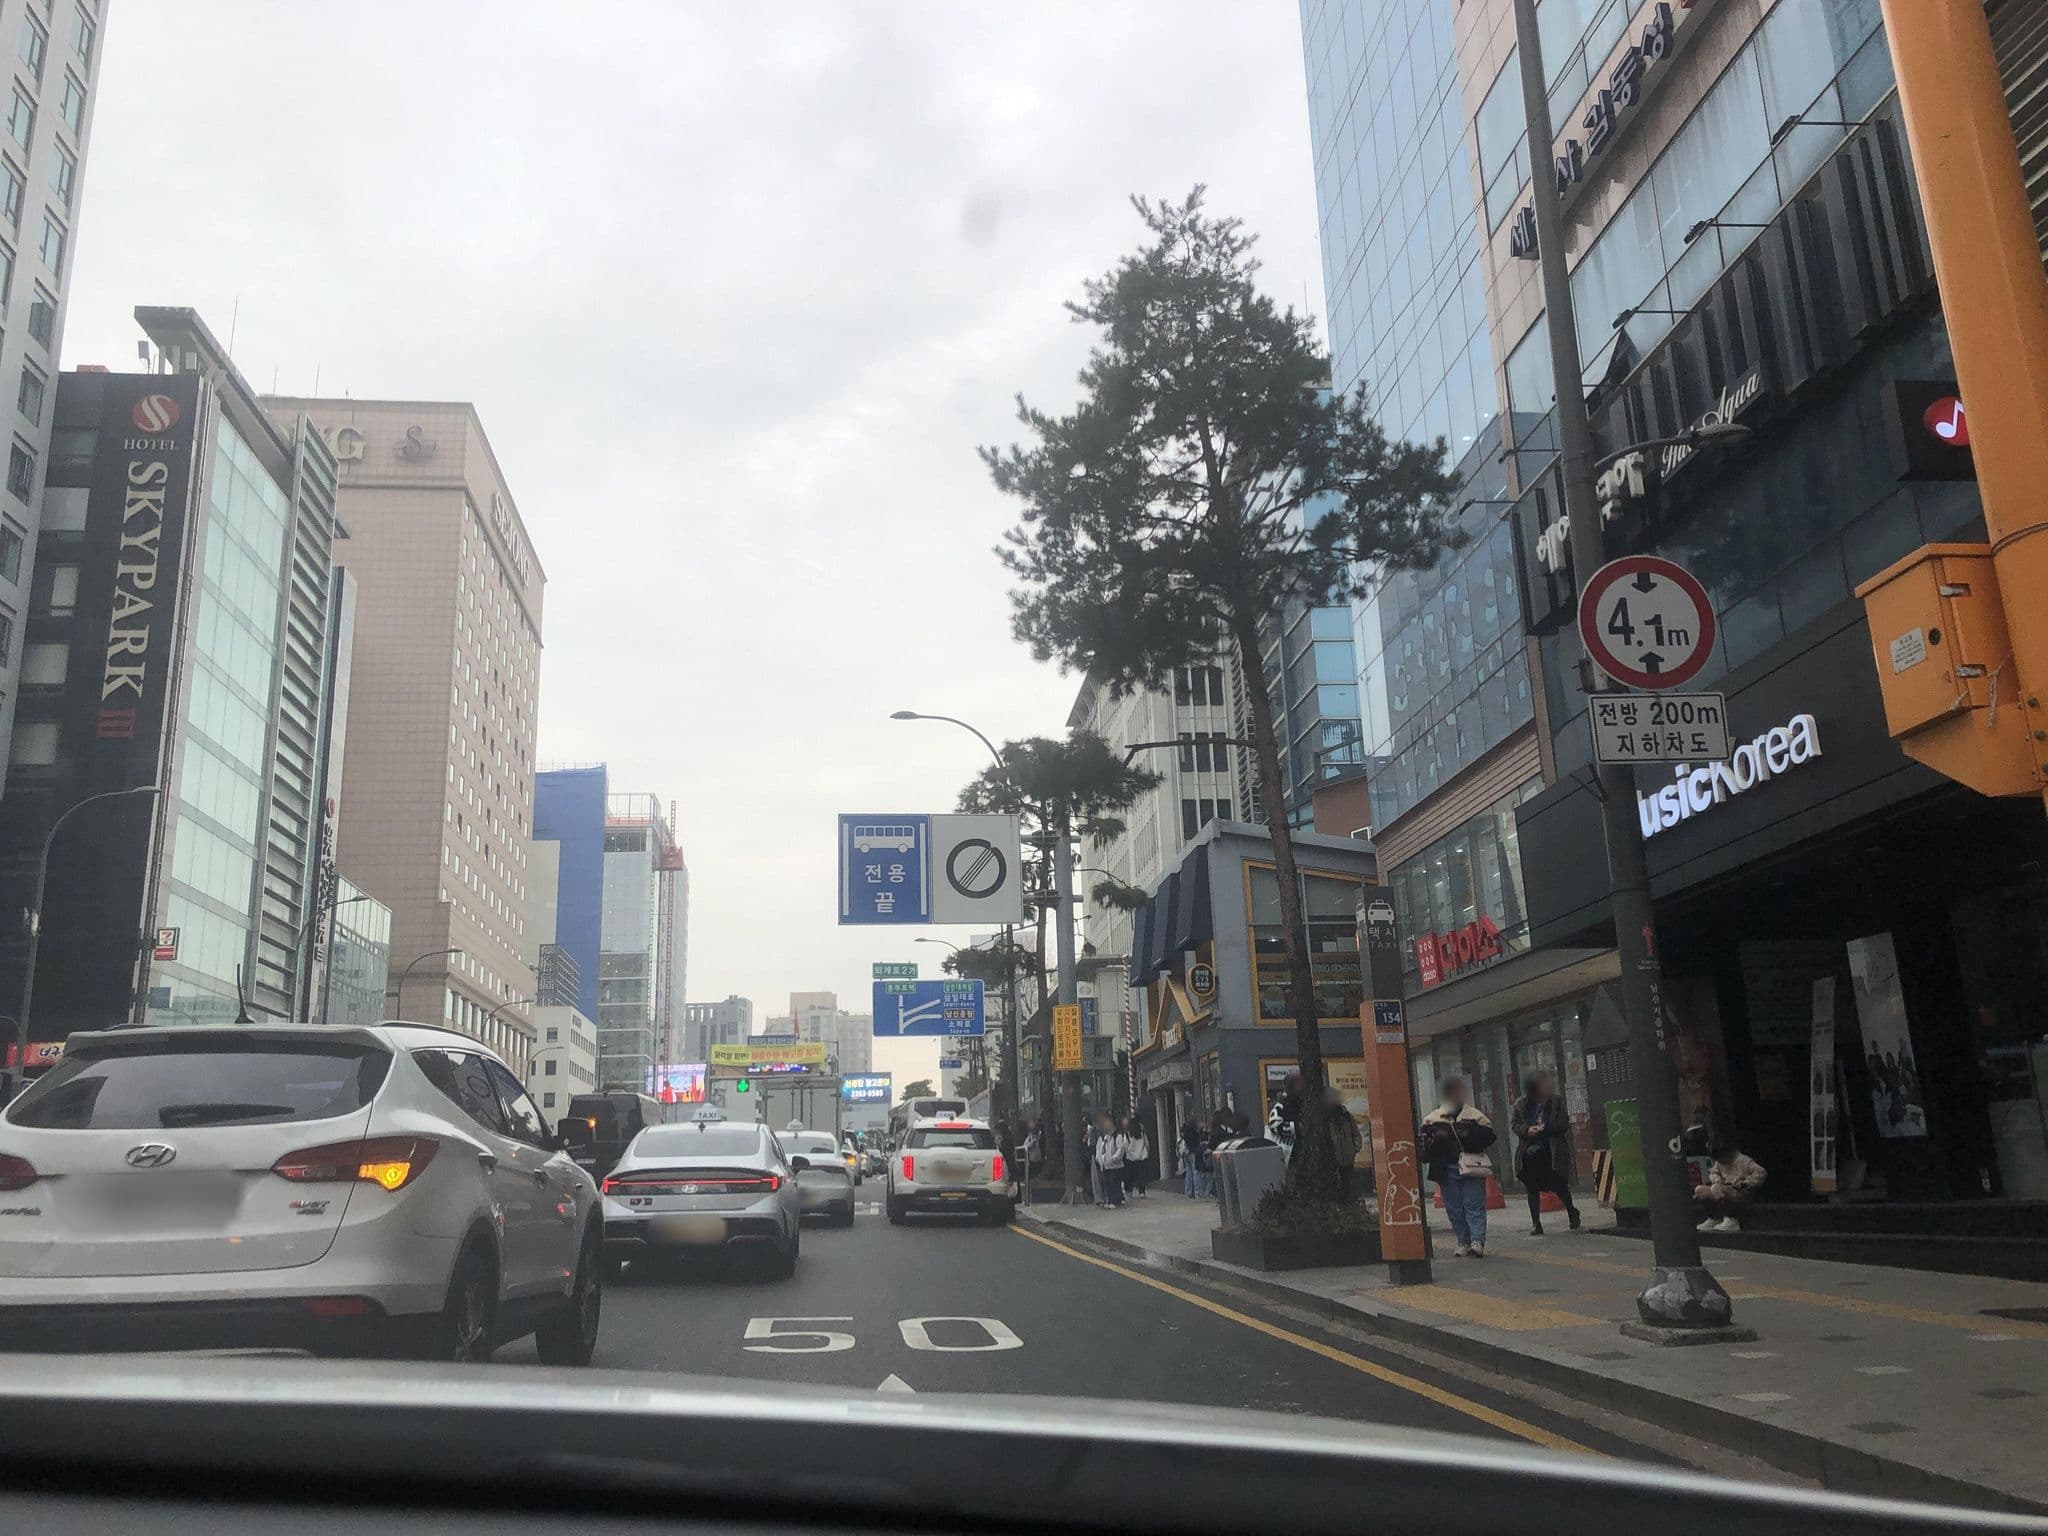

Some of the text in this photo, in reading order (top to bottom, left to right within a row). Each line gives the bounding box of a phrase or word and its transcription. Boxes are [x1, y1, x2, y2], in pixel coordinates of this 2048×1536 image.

[1702, 373, 1760, 428] Aqua
[124, 439, 176, 450] HOTEL
[102, 460, 169, 701] SKYPARK
[1607, 596, 1690, 648] 4.1m
[1599, 701, 1719, 727] 전방 200m
[1617, 731, 1710, 756] 지하차도
[864, 864, 907, 884] 전용
[875, 893, 896, 914] 끝
[1368, 926, 1396, 940] 택시
[1370, 941, 1397, 950] TAXI
[1438, 913, 1504, 971] 다이소
